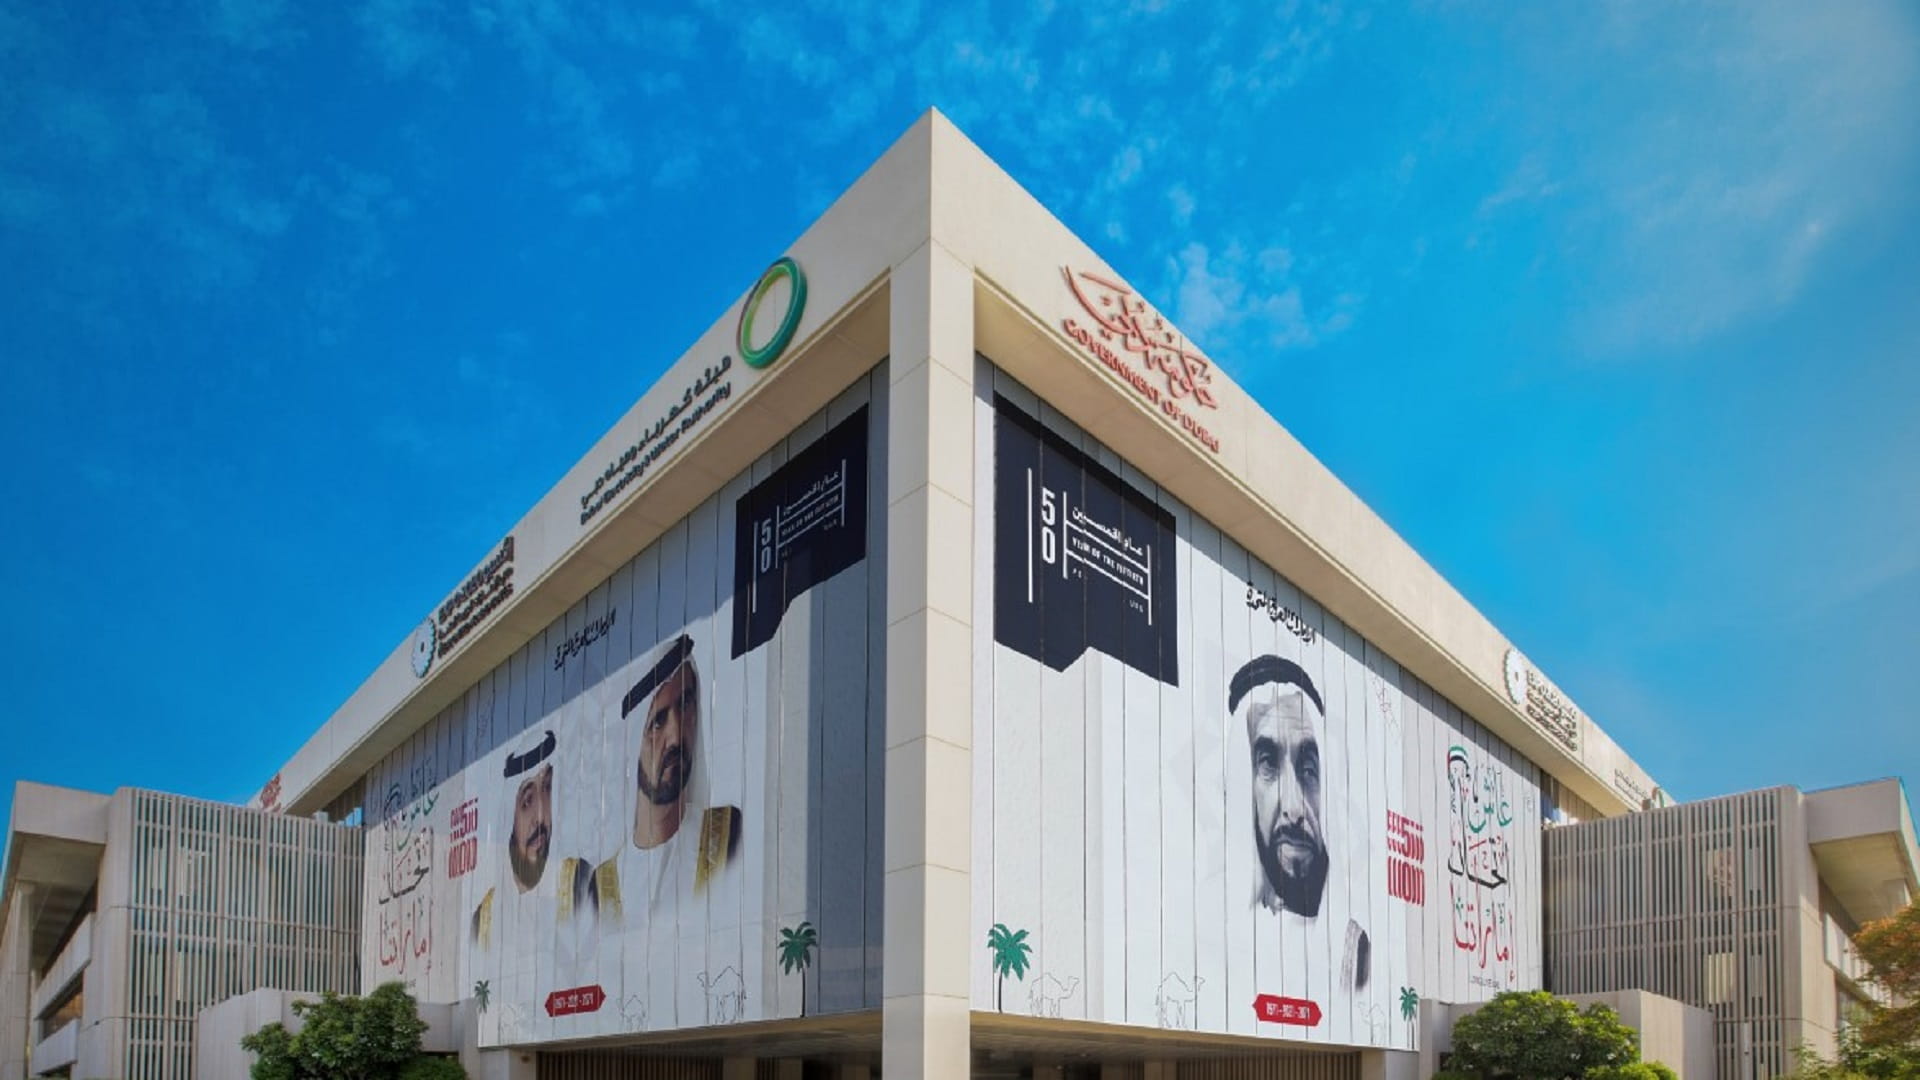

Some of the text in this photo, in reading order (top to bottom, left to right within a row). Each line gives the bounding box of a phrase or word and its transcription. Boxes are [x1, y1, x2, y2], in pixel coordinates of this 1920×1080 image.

[681, 381, 731, 434] Authority
[1062, 319, 1160, 405] GOVERNMENT
[1163, 402, 1182, 420] OF
